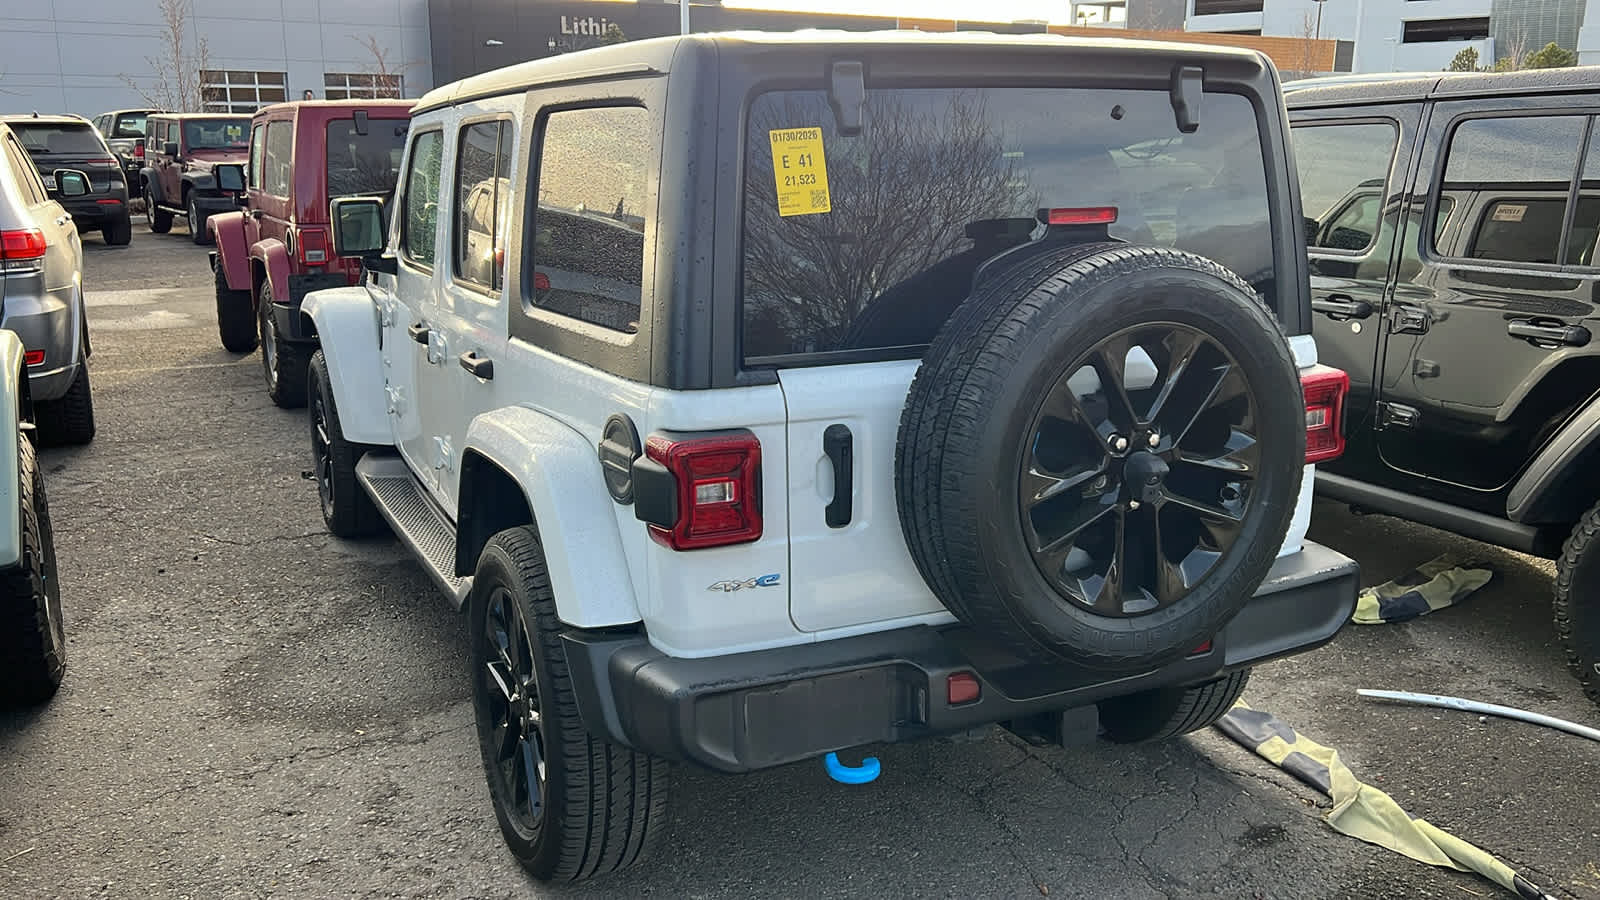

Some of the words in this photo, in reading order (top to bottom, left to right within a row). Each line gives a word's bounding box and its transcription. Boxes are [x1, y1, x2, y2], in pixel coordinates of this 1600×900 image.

[773, 131, 818, 142] 01/30/2026
[782, 155, 790, 169] E
[799, 154, 812, 167] 41
[785, 175, 816, 187] 21,523
